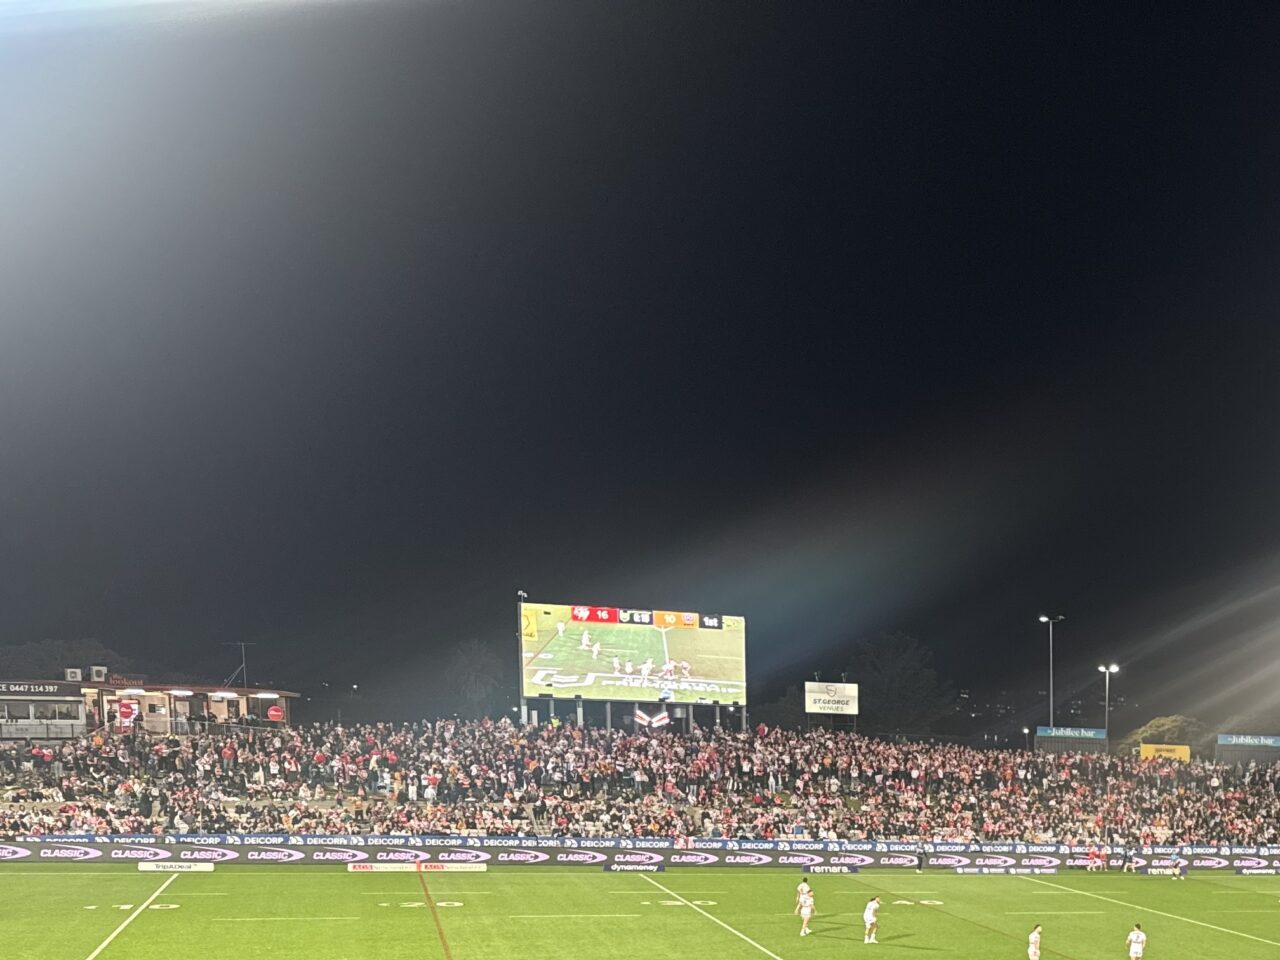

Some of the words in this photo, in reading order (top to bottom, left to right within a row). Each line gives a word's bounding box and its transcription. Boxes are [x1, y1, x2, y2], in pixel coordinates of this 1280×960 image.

[597, 610, 609, 620] 16
[664, 614, 676, 624] 10
[703, 617, 719, 627] 1st
[818, 705, 845, 713] VENUES
[1051, 727, 1080, 737] Jubilee
[1081, 728, 1096, 737] bar
[1231, 735, 1259, 744] Jubilee
[1260, 735, 1275, 745] bar
[368, 838, 406, 846] DEICORP
[426, 838, 462, 846] DEICORP
[484, 838, 520, 846] DEICORP
[581, 840, 616, 848] DEICORP
[742, 842, 774, 850] DEICORP
[40, 849, 85, 858] CLASSIC
[111, 850, 155, 859] CLASSIC
[181, 850, 223, 860] CLASSIC
[248, 851, 288, 860] CLASSIC
[313, 852, 352, 860] CLASSIC
[376, 852, 416, 860] CLASSIC
[438, 852, 476, 860] CLASSIC
[498, 853, 534, 861] CLASSIC
[557, 854, 593, 862] CLASSIC
[614, 854, 650, 862] CLASSIC
[670, 854, 705, 862] CLASSIC
[725, 855, 758, 863] CLASSIC
[778, 856, 811, 864] CLASSIC
[880, 857, 910, 865] CLASSIC
[929, 858, 958, 866] CLASSIC
[976, 858, 1004, 866] CLASSIC
[1022, 858, 1050, 866] CLASSIC
[611, 864, 658, 872] dynamoney
